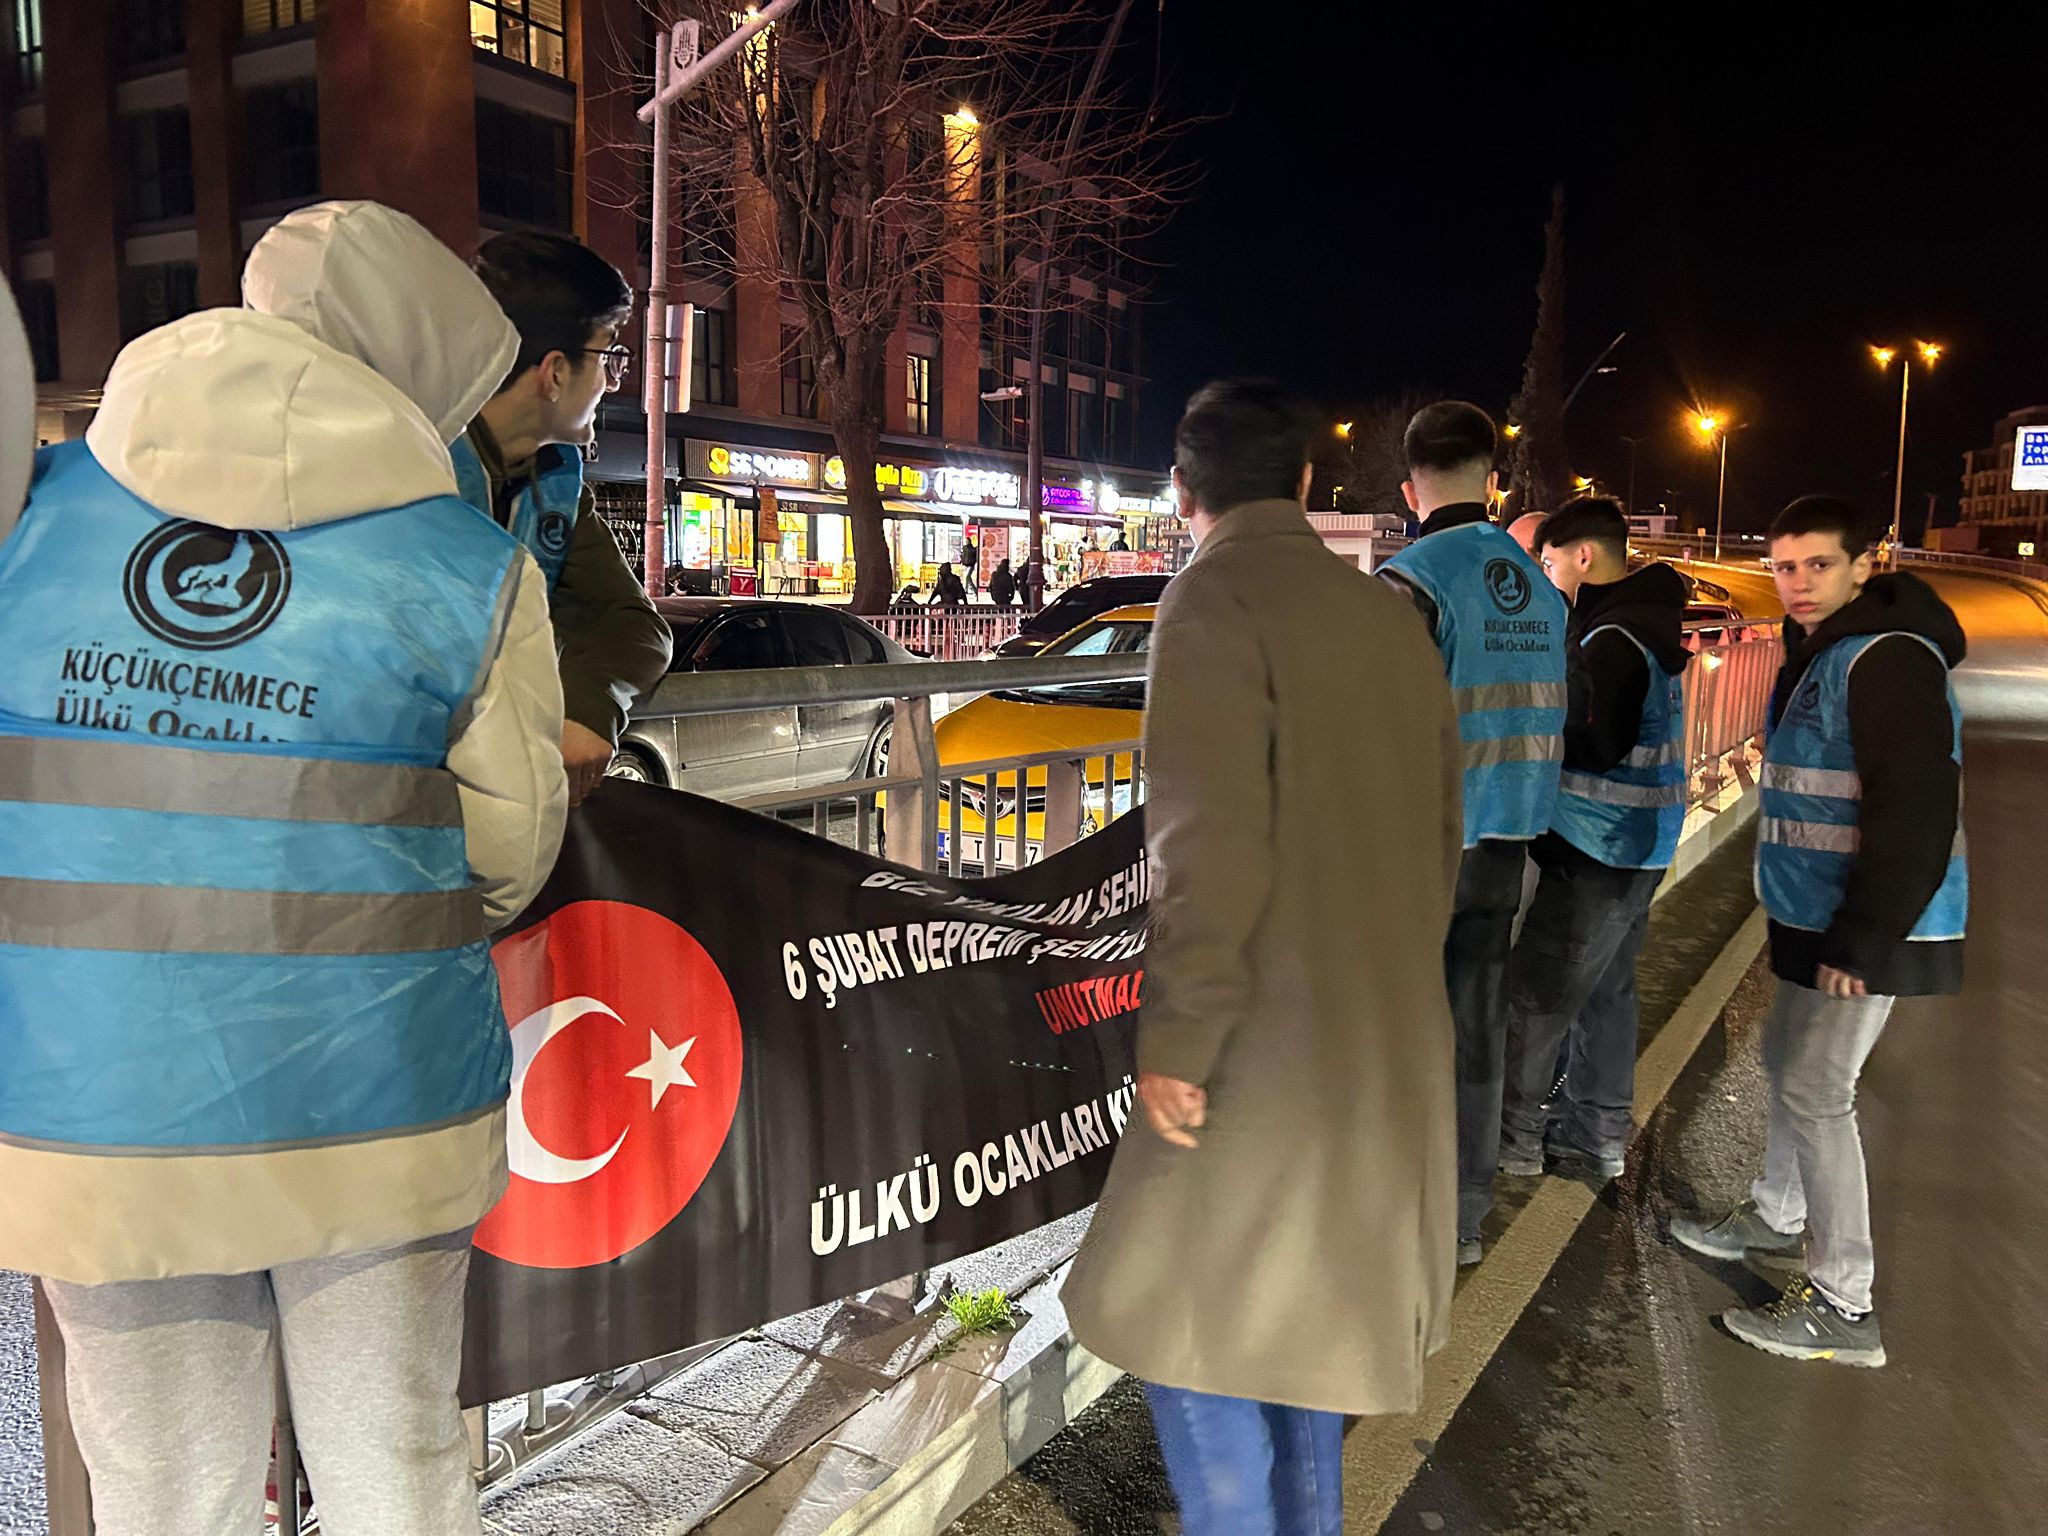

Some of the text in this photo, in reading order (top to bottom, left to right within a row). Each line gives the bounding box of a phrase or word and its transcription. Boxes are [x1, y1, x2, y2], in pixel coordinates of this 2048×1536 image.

[61, 642, 319, 719] KÜÇÜKÇEKMECE
[782, 941, 808, 1001] 6
[808, 928, 904, 1008] ŞUBAT
[906, 921, 1030, 974] DEPREM
[810, 1154, 940, 1256] ÜLKÜ
[954, 1099, 1110, 1207] OCAKLARI
